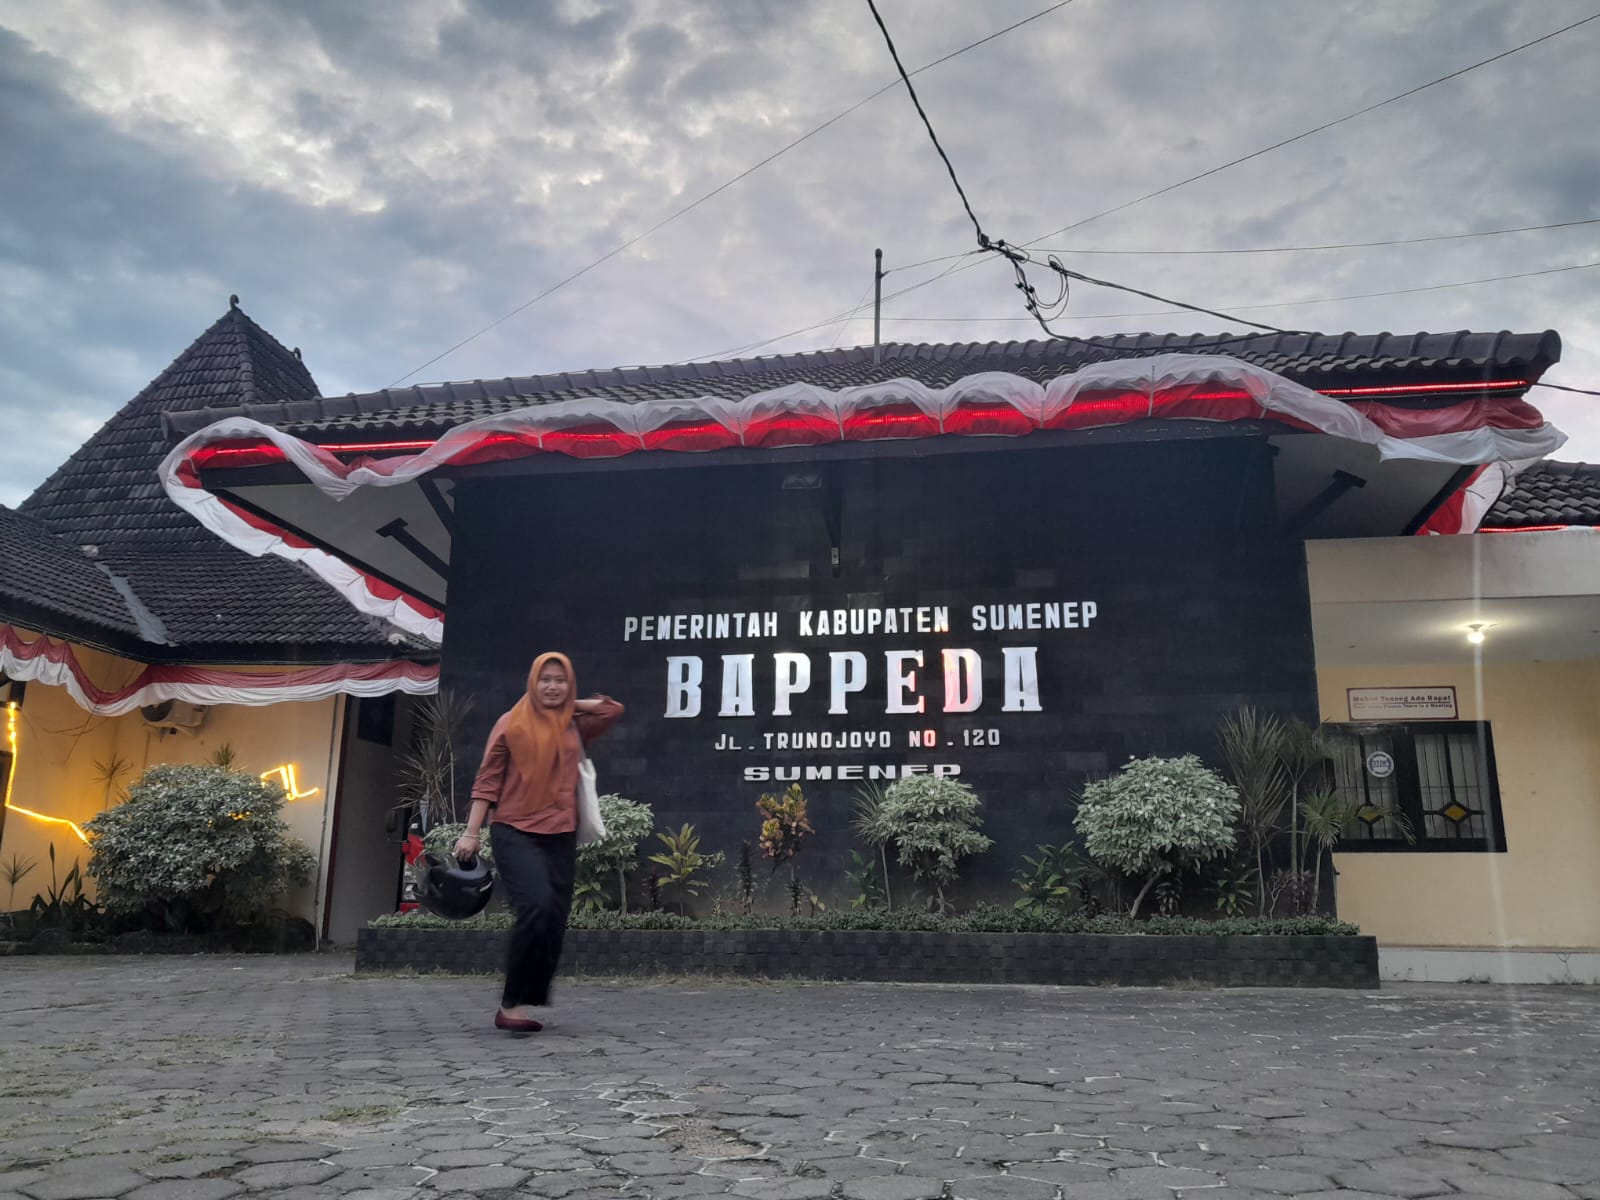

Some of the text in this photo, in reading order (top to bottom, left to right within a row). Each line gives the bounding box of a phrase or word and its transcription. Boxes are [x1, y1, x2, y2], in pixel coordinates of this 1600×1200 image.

[624, 600, 1098, 642] PEMERINTAH KABUPATEN SUMENEP
[663, 646, 1043, 718] BAPPEDA
[763, 730, 891, 750] TRUNOJOYO
[963, 728, 1000, 746] 120
[743, 764, 961, 781] SUMENEP
